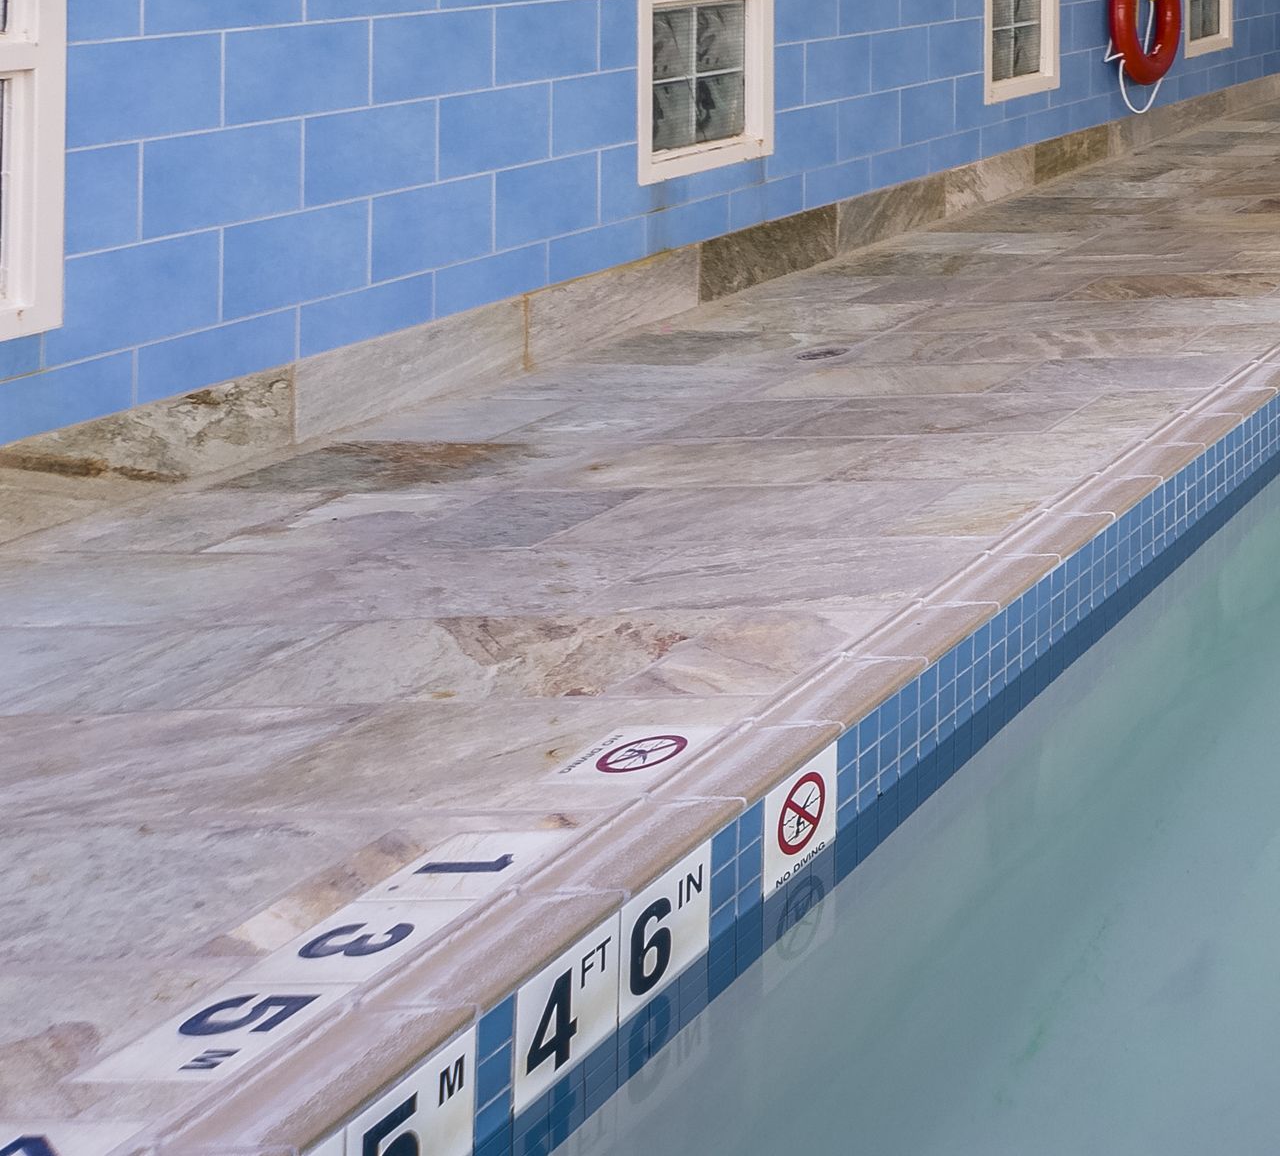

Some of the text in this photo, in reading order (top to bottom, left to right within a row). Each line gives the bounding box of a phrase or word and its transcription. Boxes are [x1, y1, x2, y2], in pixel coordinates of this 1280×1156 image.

[775, 841, 826, 889] NO DIVING
[526, 864, 703, 1076] 4 FT 6 IN
